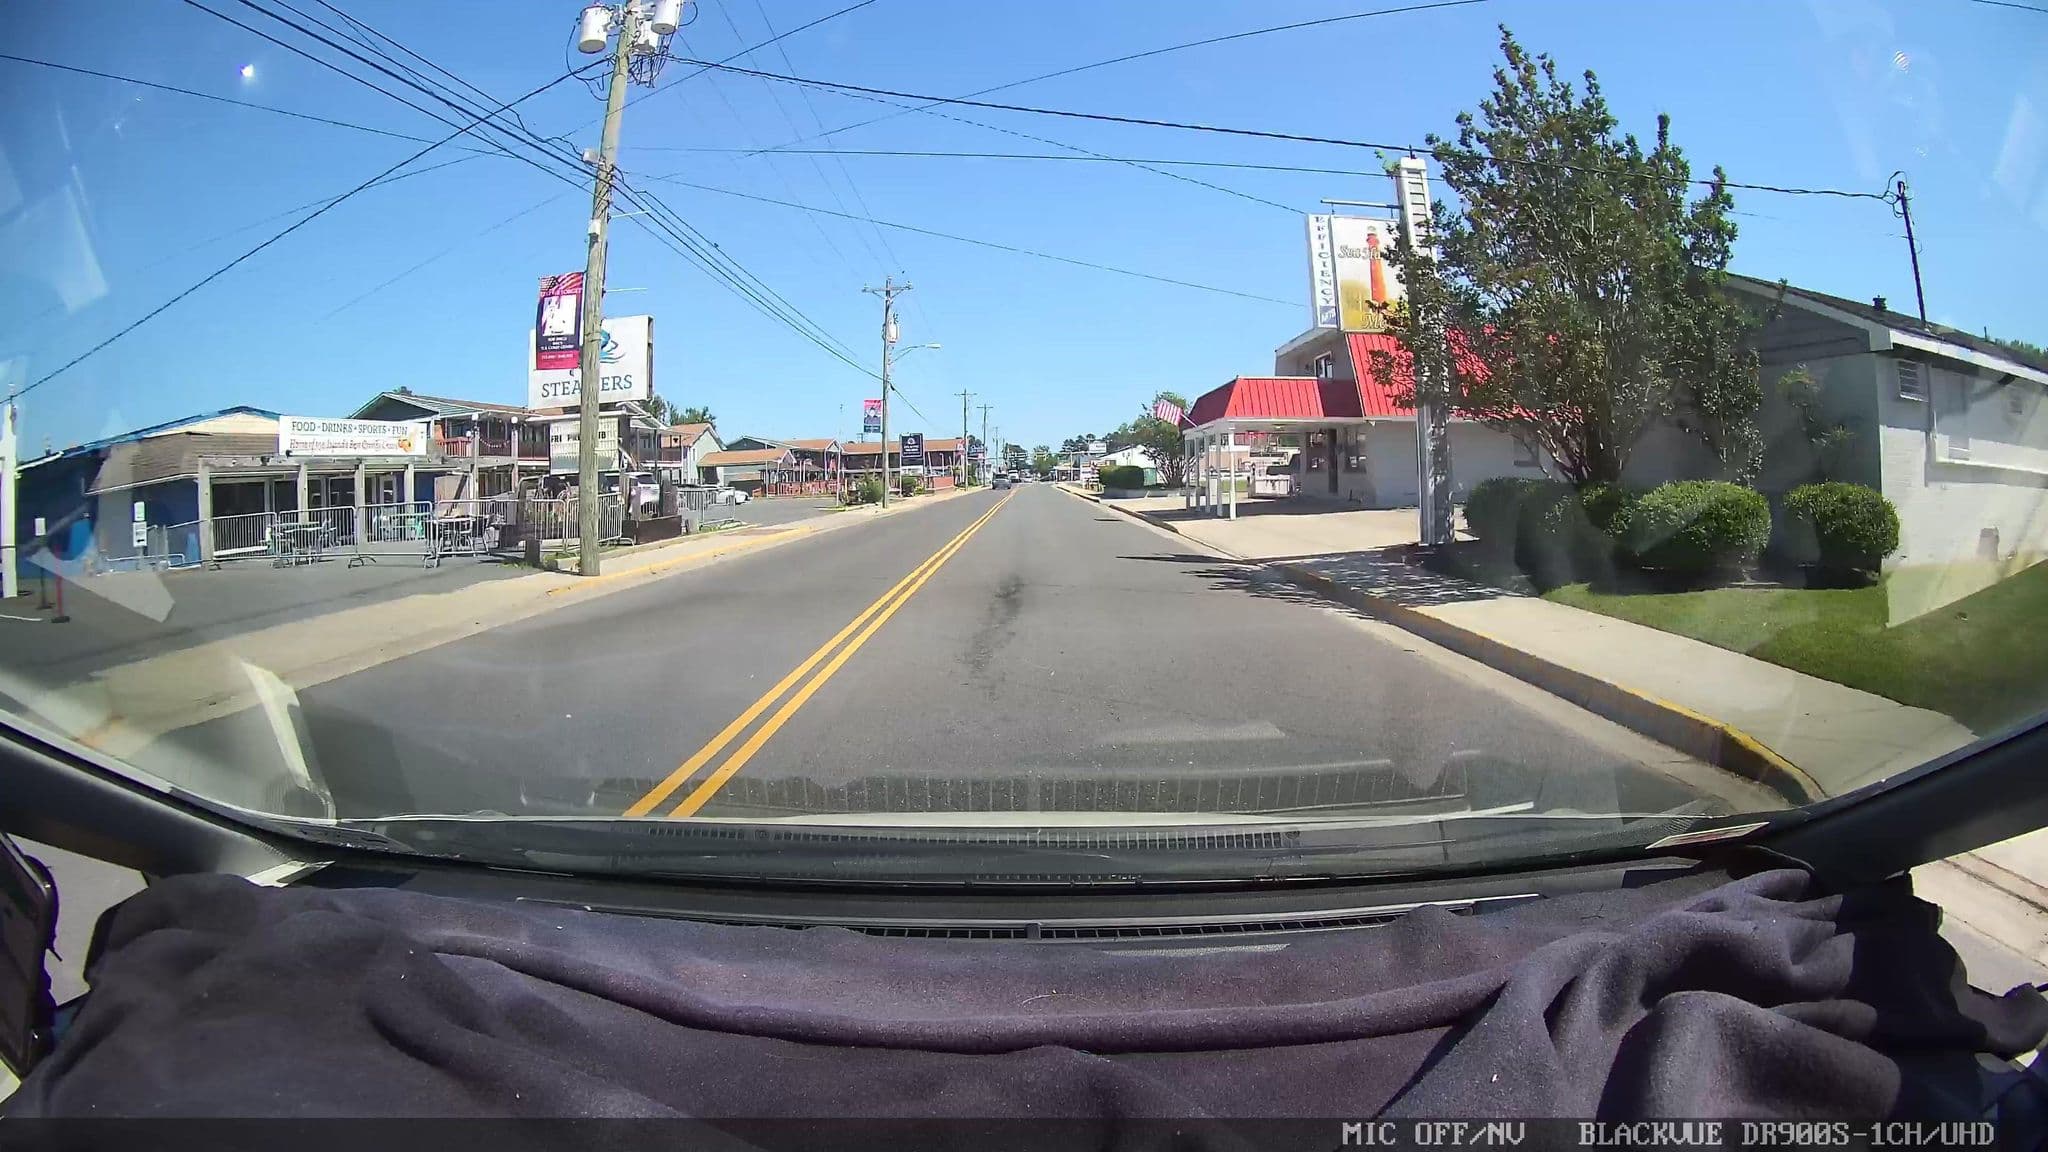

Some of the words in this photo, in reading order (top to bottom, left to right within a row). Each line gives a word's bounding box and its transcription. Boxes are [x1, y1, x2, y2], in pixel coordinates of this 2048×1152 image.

[541, 374, 633, 398] STEAERS
[292, 421, 316, 432] FOOD
[322, 423, 353, 433] DRINKS
[358, 424, 387, 434] SPORTS
[392, 426, 408, 435] FUN
